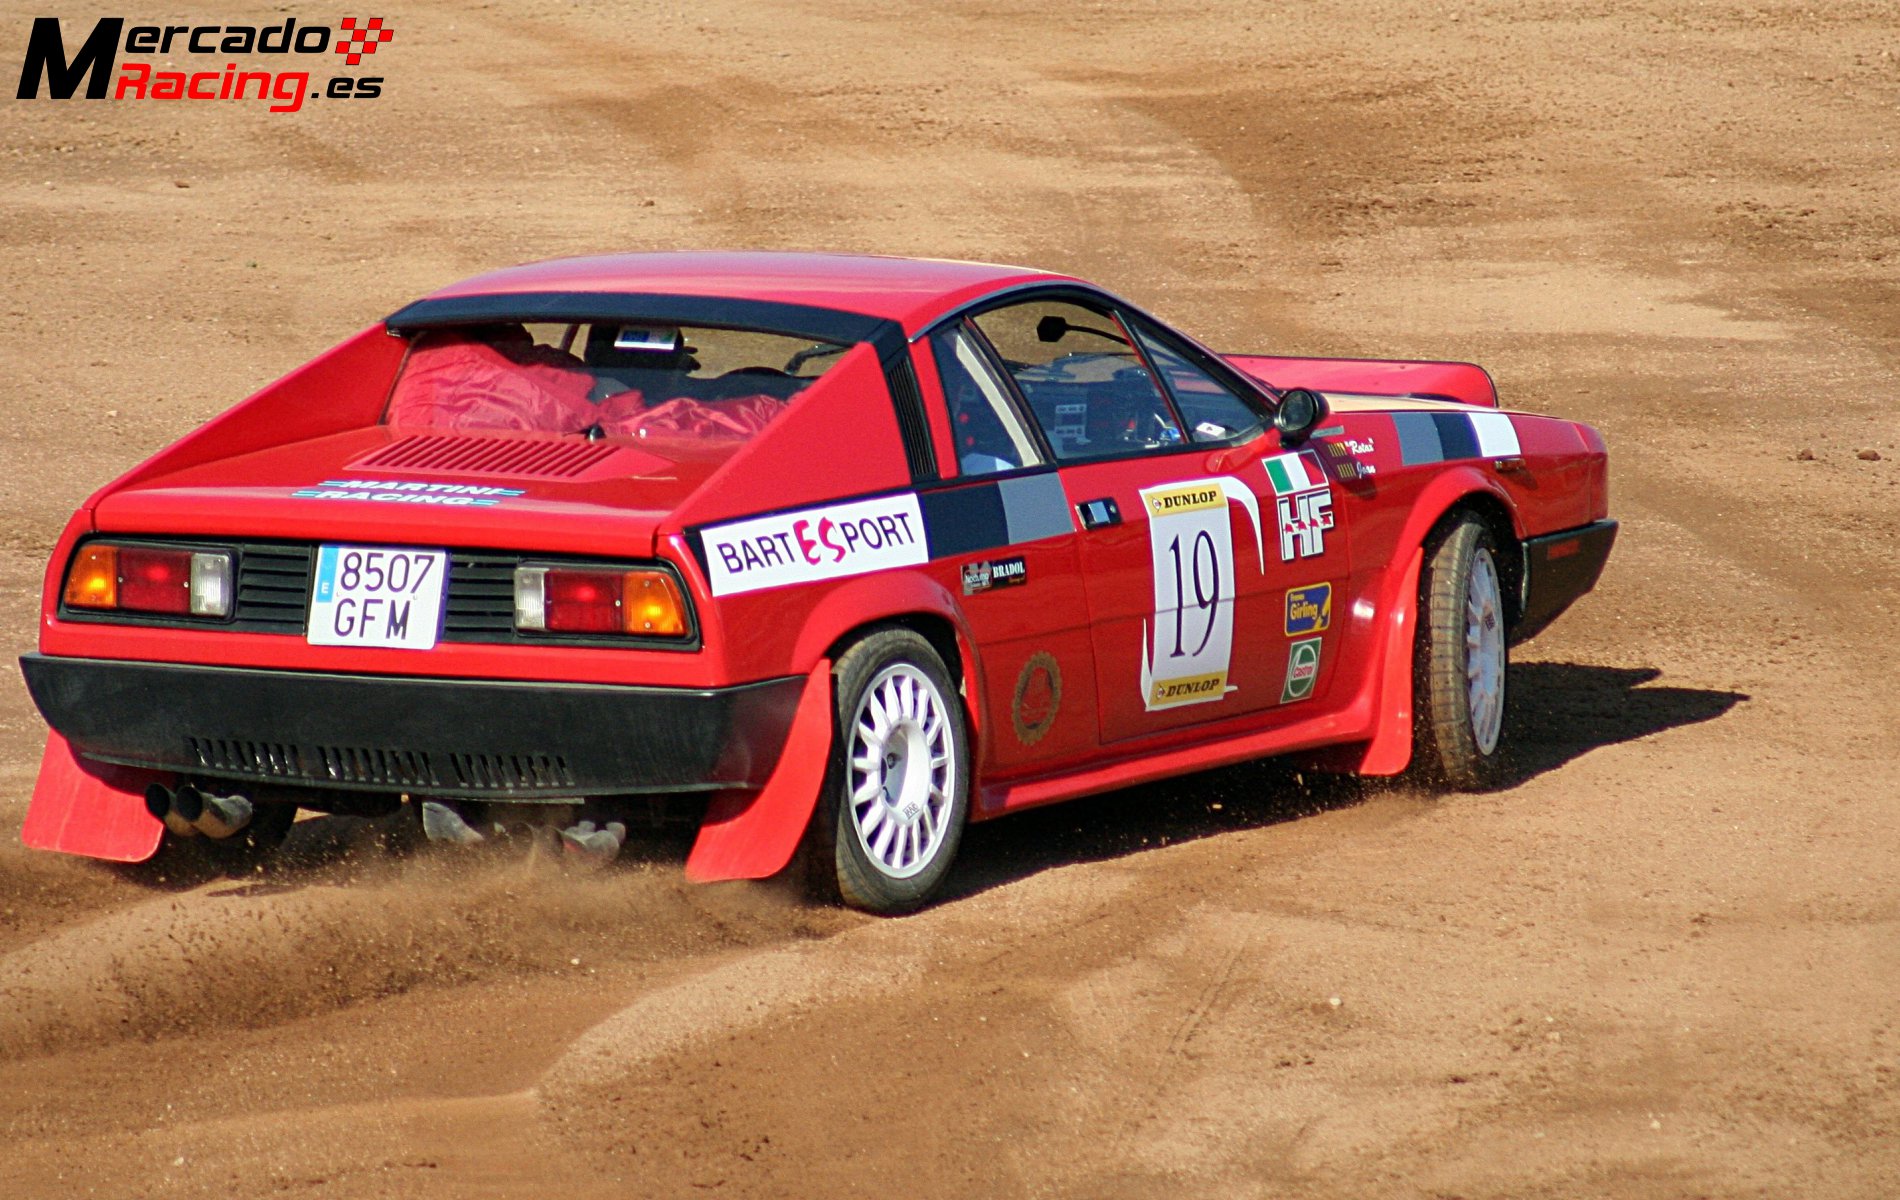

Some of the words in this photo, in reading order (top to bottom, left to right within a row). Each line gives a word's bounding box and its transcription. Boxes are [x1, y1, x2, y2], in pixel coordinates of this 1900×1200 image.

[315, 490, 474, 505] RACING
[341, 480, 504, 496] MARTINI
[1163, 490, 1217, 508] DUNLOP
[1277, 489, 1335, 561] HF
[717, 512, 910, 574] BARTESPORT
[340, 551, 435, 593] 8507
[992, 561, 1025, 578] BRADOL
[321, 582, 330, 594] E
[1169, 530, 1219, 658] 19
[334, 598, 411, 640] GFM
[1290, 601, 1318, 620] Girling
[1166, 678, 1220, 697] DUNLOP
